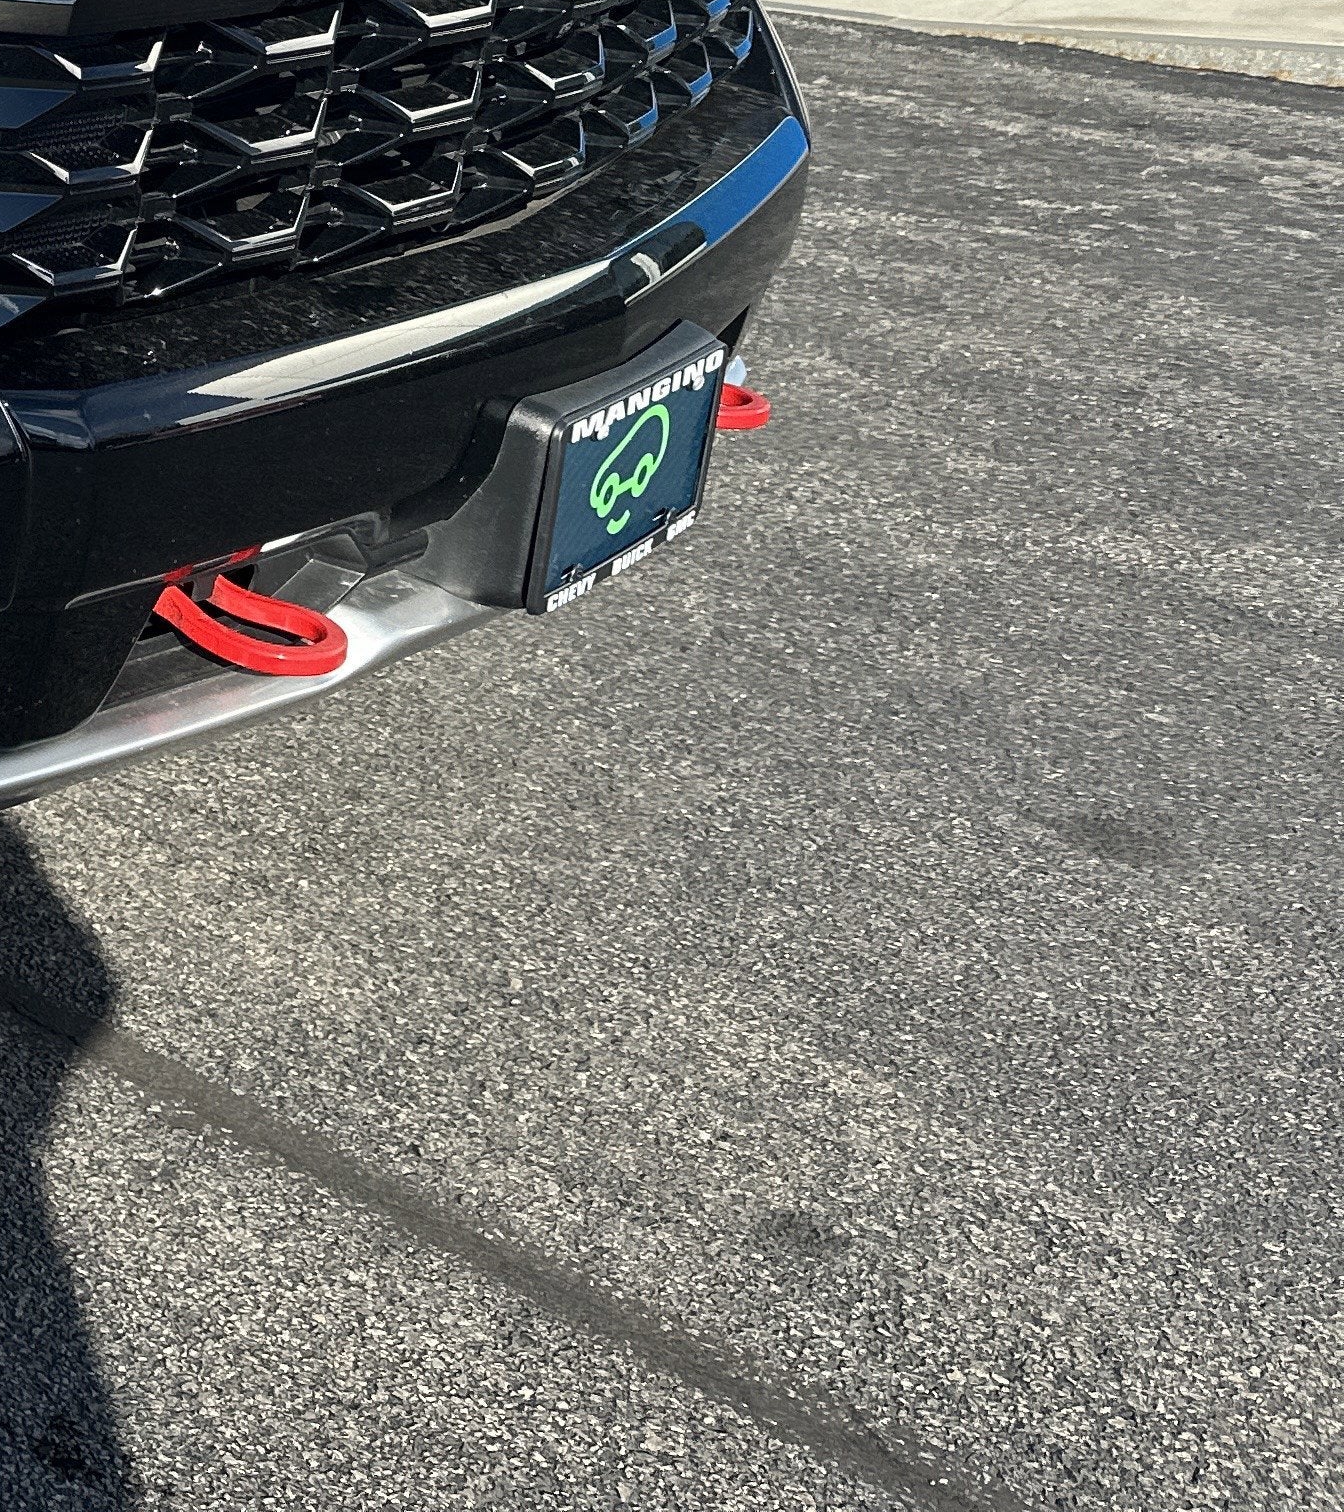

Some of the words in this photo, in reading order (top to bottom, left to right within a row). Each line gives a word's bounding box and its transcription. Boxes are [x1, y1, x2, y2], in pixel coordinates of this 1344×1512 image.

[571, 349, 724, 443] MANGINO
[546, 573, 596, 612] CHEVY
[612, 538, 653, 576] BUICK
[666, 510, 696, 541] GMC
